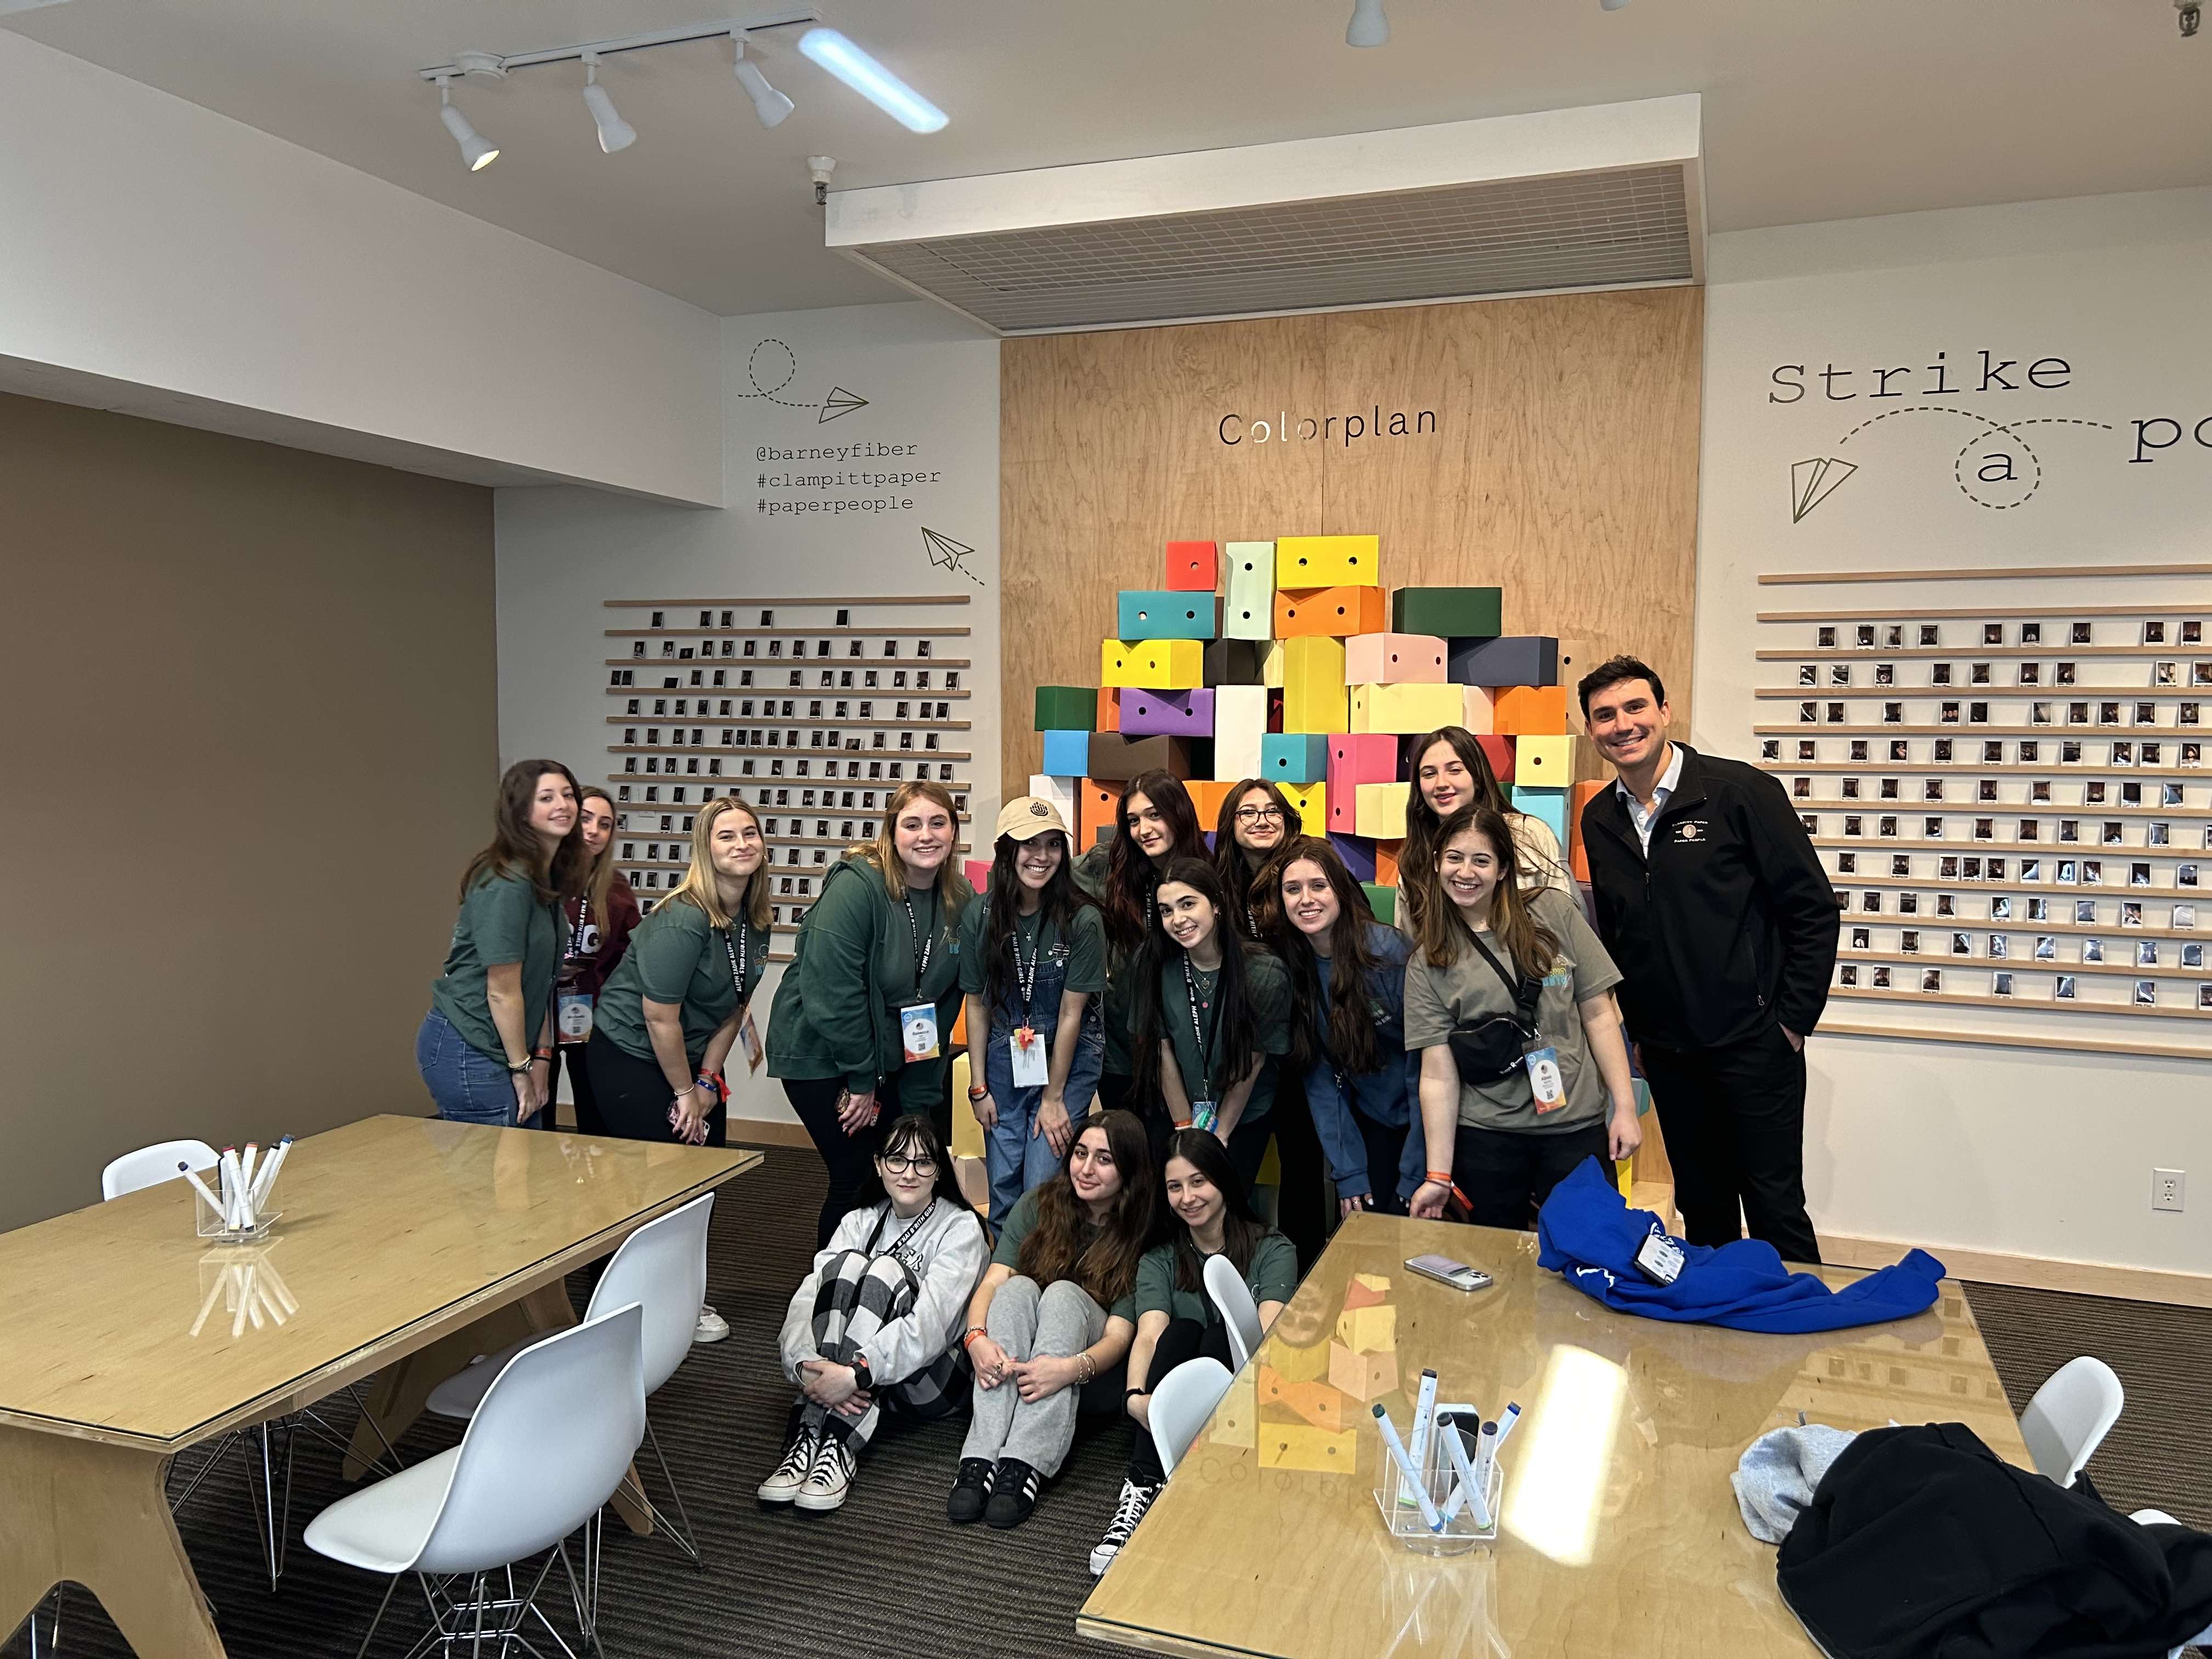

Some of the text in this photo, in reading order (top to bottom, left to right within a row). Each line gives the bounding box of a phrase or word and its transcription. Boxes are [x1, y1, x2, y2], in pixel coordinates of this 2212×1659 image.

[1769, 350, 2071, 404] Strike
[1218, 405, 1436, 447] Colorplan
[757, 443, 918, 461] @barneyfiber
[757, 470, 941, 488] #clampittpaper
[1977, 453, 2018, 482] a
[757, 496, 913, 515] #paperpeople
[726, 942, 742, 992] ALEPH ZADIK ALEPH
[897, 1231, 911, 1247] B'NAI
[910, 1215, 926, 1234] B'RITH
